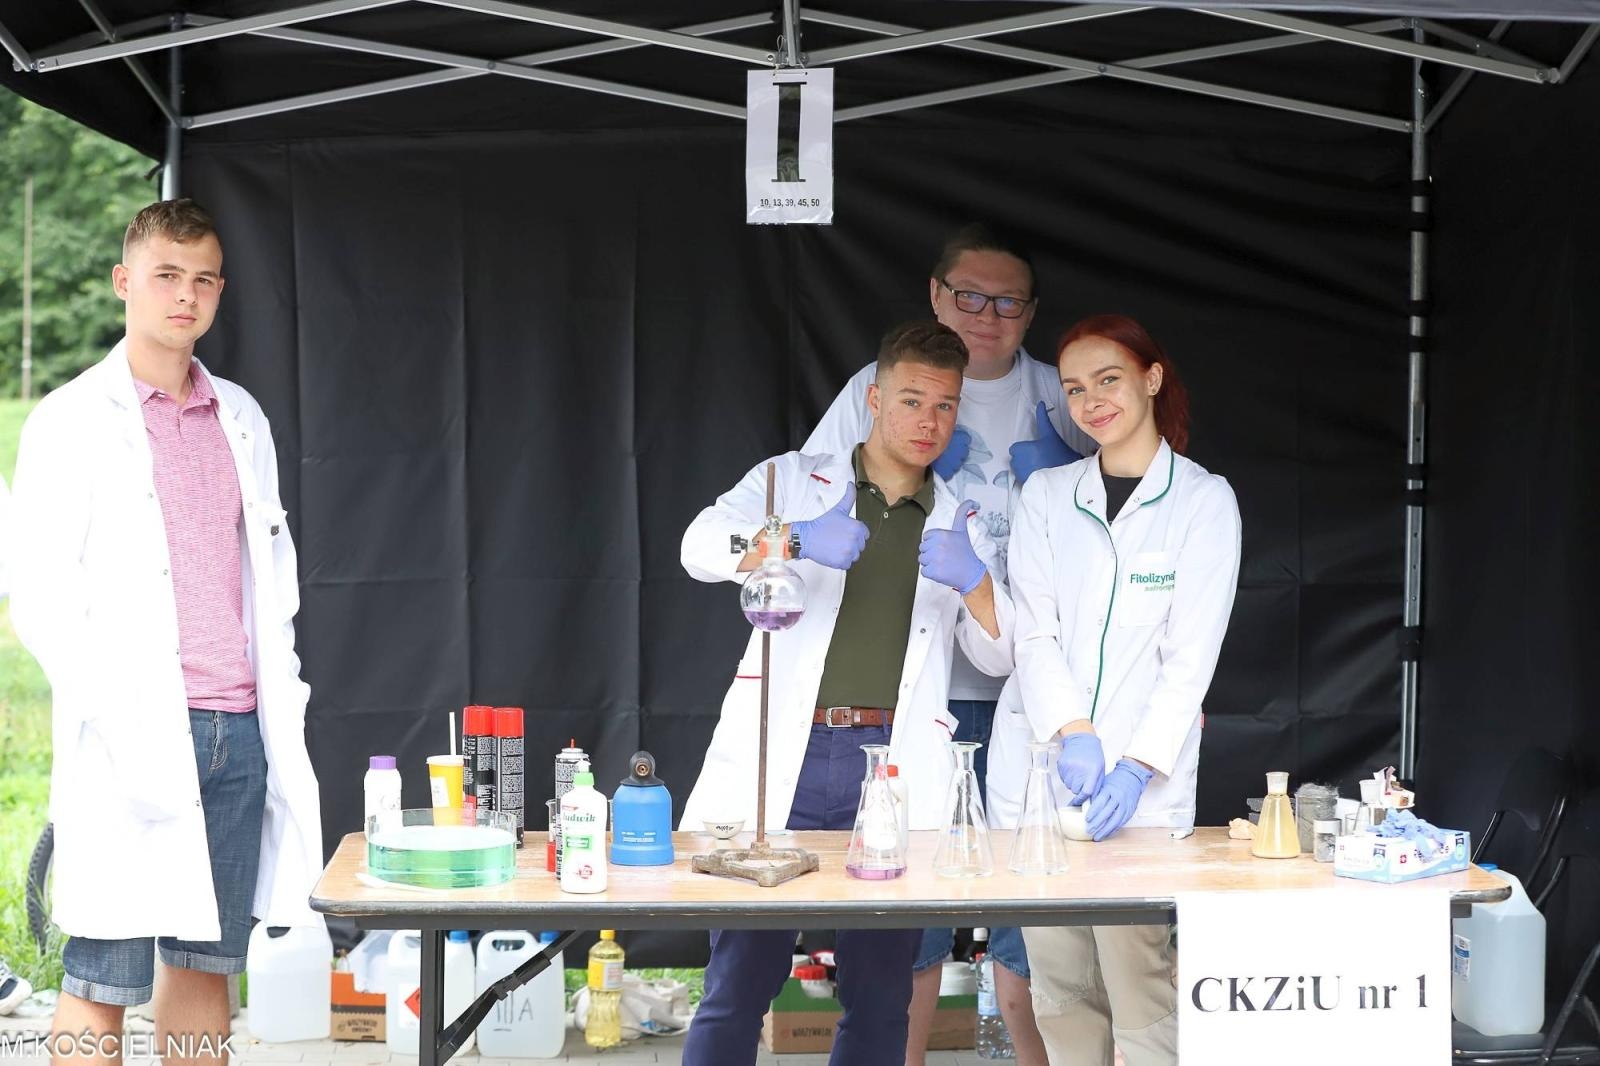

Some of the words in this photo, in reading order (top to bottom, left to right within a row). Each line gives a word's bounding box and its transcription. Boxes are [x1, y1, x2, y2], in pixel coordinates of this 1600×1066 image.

[760, 198, 771, 208] 10,
[773, 198, 784, 208] 13,
[785, 198, 796, 208] 39,
[798, 198, 809, 208] 45,
[811, 198, 820, 207] 50
[1130, 572, 1175, 585] Fitolizyna
[1191, 975, 1343, 1012] CKZiU
[1358, 985, 1398, 1009] nr
[1416, 974, 1428, 1008] 1
